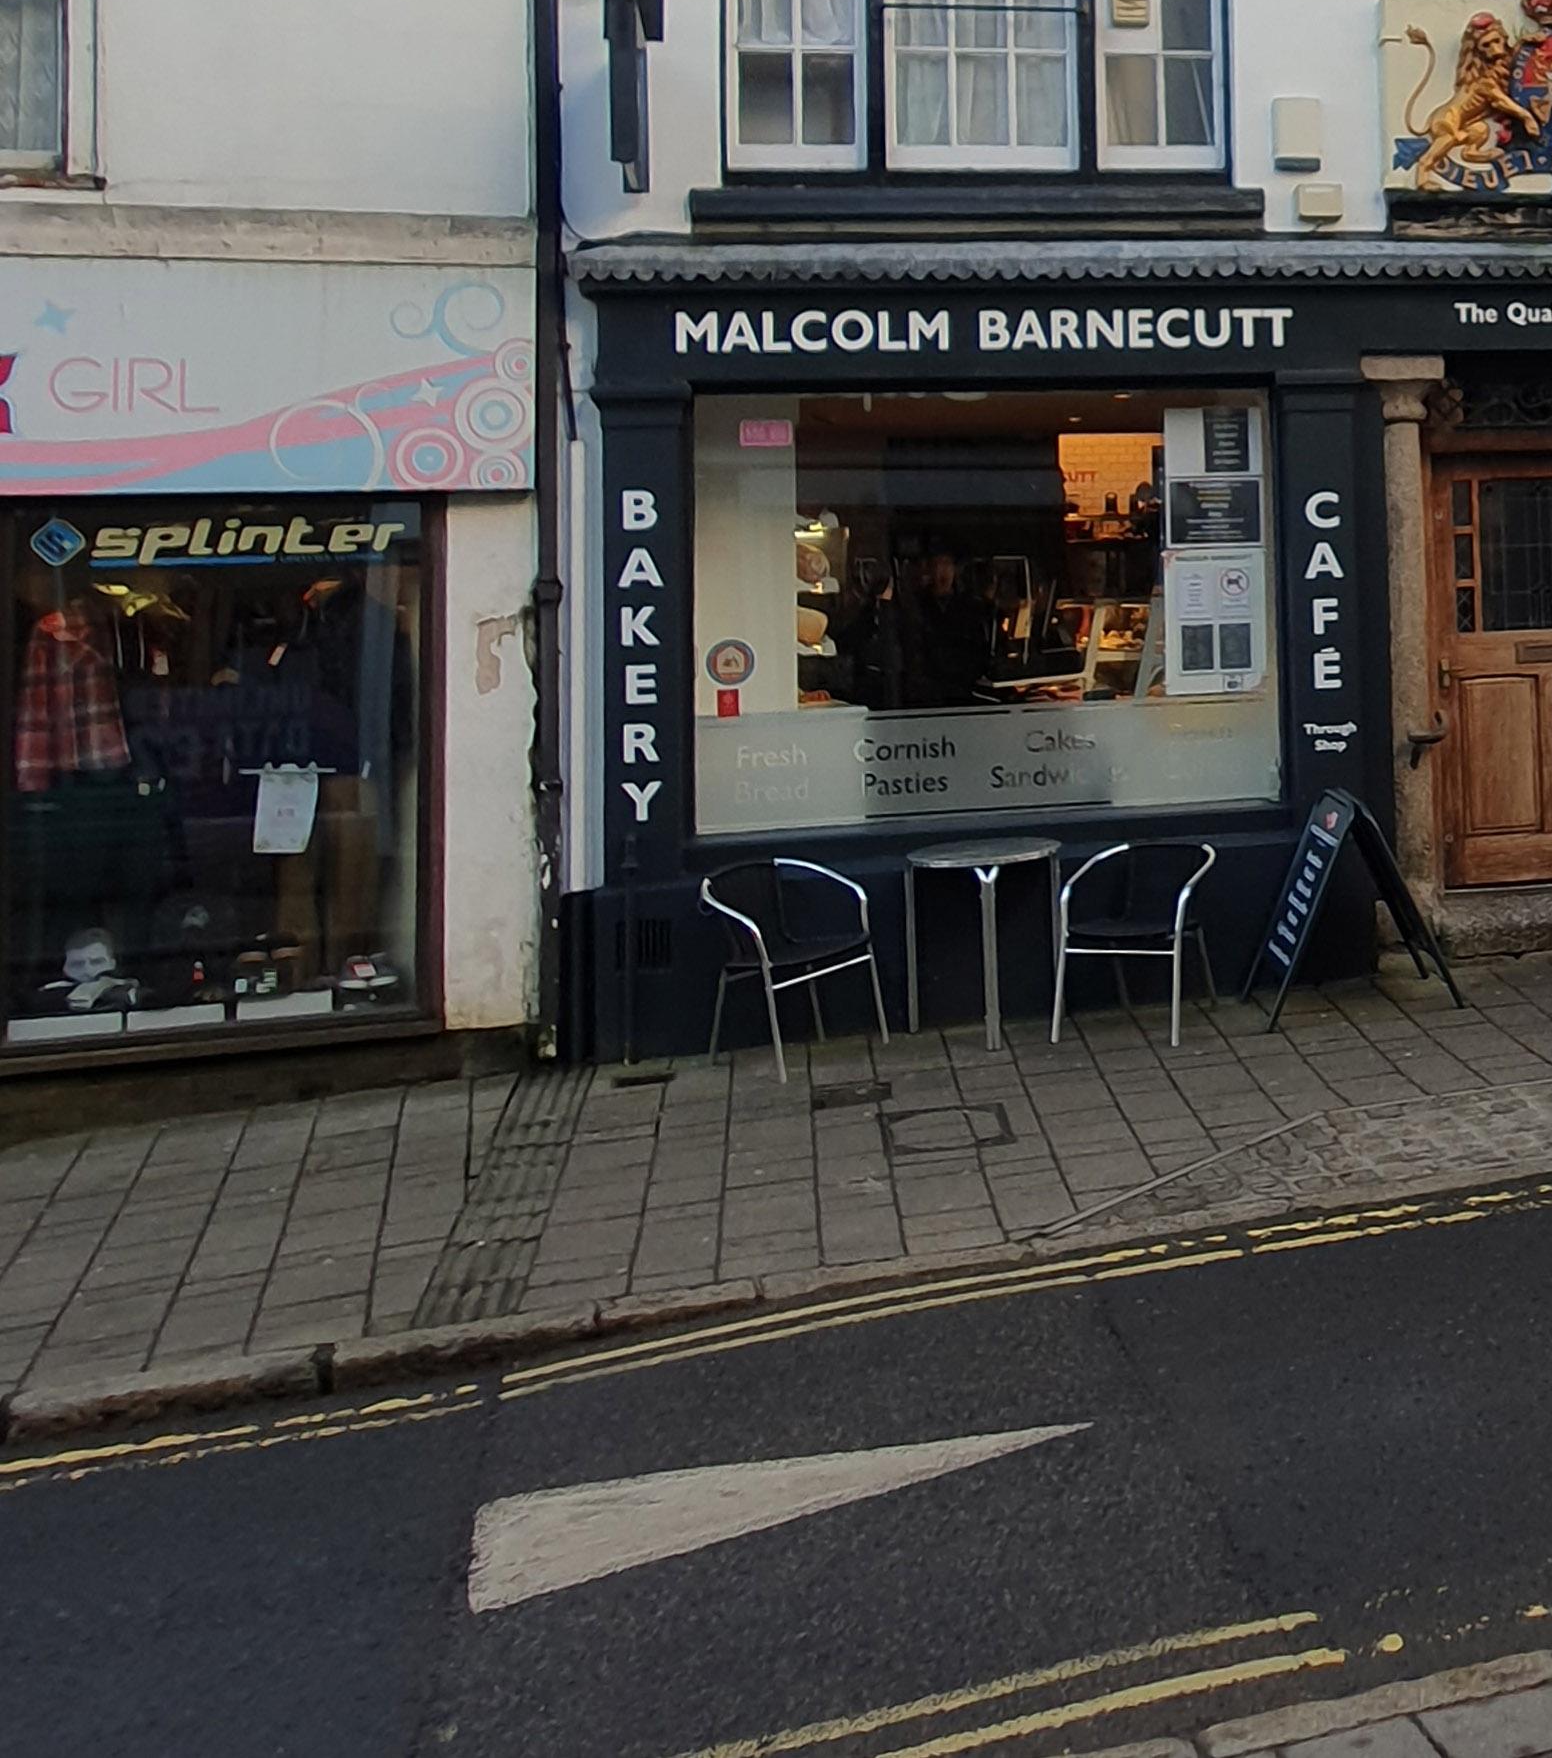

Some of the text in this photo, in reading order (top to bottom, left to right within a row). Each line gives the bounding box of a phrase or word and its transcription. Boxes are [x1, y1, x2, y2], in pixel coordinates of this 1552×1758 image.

[1453, 302, 1498, 324] The
[674, 307, 1294, 354] MALCOLM BARNECUTT
[48, 356, 220, 414] GIRL
[1304, 491, 1345, 690] CAFÉ
[617, 489, 664, 822] BAKERY
[853, 735, 957, 763] Cornish
[1025, 728, 1096, 753] Cakes
[735, 743, 809, 769] Fresh
[734, 777, 810, 804] Bread
[861, 771, 949, 798] Pasties
